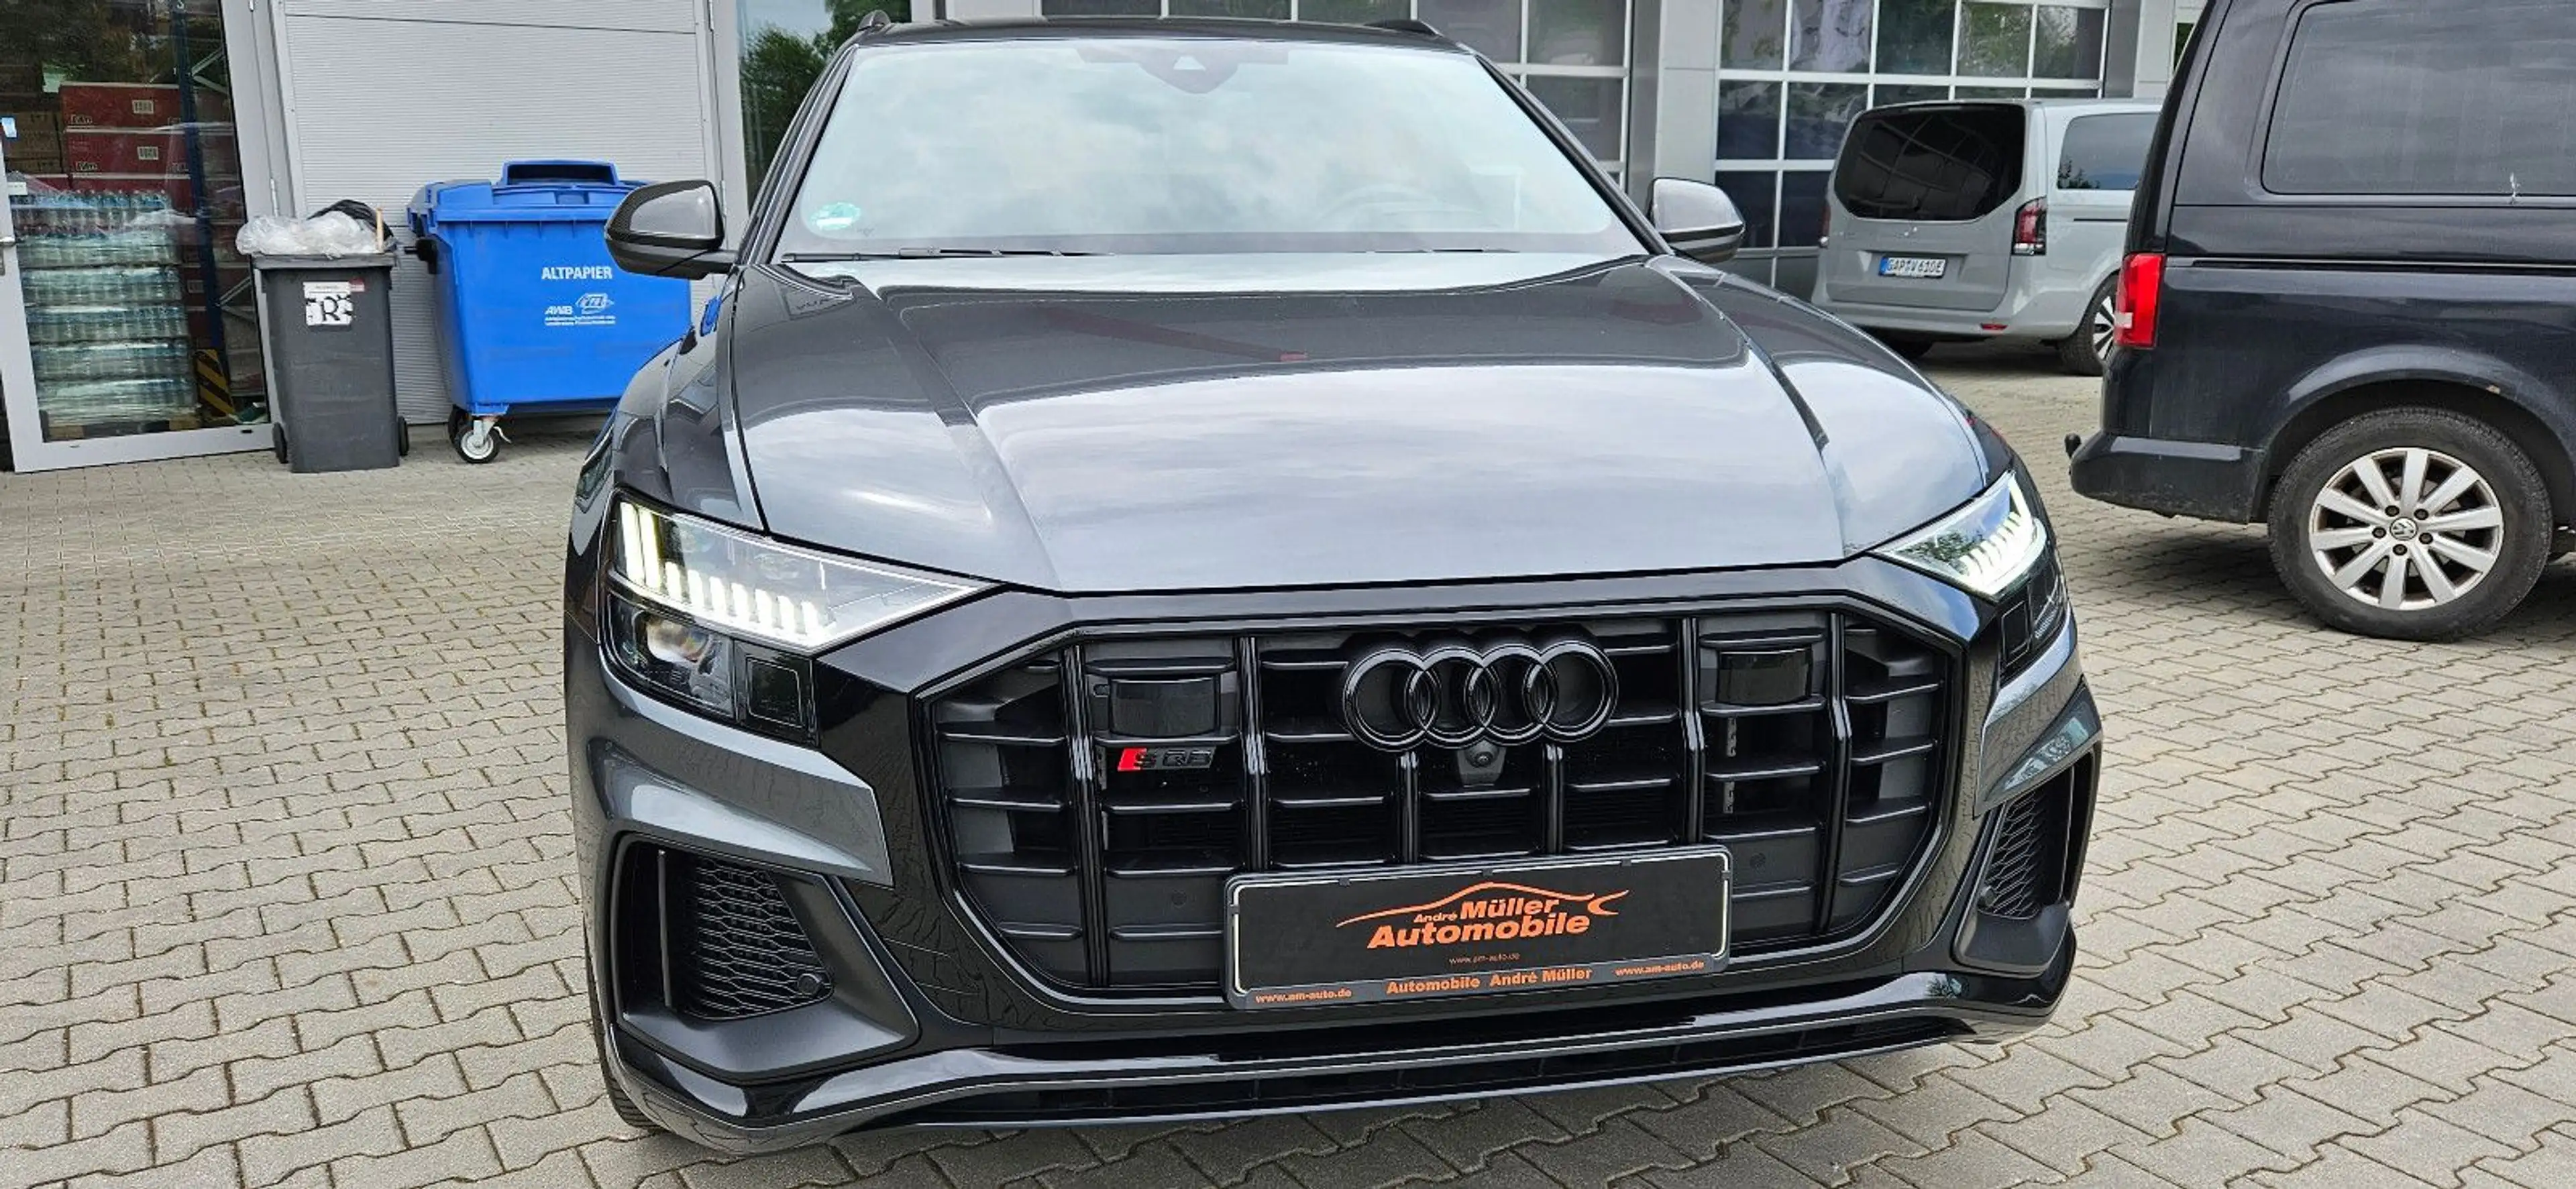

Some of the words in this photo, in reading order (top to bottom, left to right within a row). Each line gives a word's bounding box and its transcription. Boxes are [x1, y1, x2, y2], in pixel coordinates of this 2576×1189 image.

[541, 266, 612, 280] ALTPAPIER
[322, 296, 340, 321] R
[545, 305, 573, 315] AWB
[1413, 912, 1457, 923] André
[1460, 897, 1559, 919] Müller
[1366, 913, 1590, 949] Automobile
[1255, 987, 1352, 1003] www.am-auto.de
[1386, 976, 1481, 994] Automobile
[1489, 971, 1538, 986] André
[1542, 968, 1593, 982] Müller
[1615, 960, 1705, 976] www.am-auto.de
